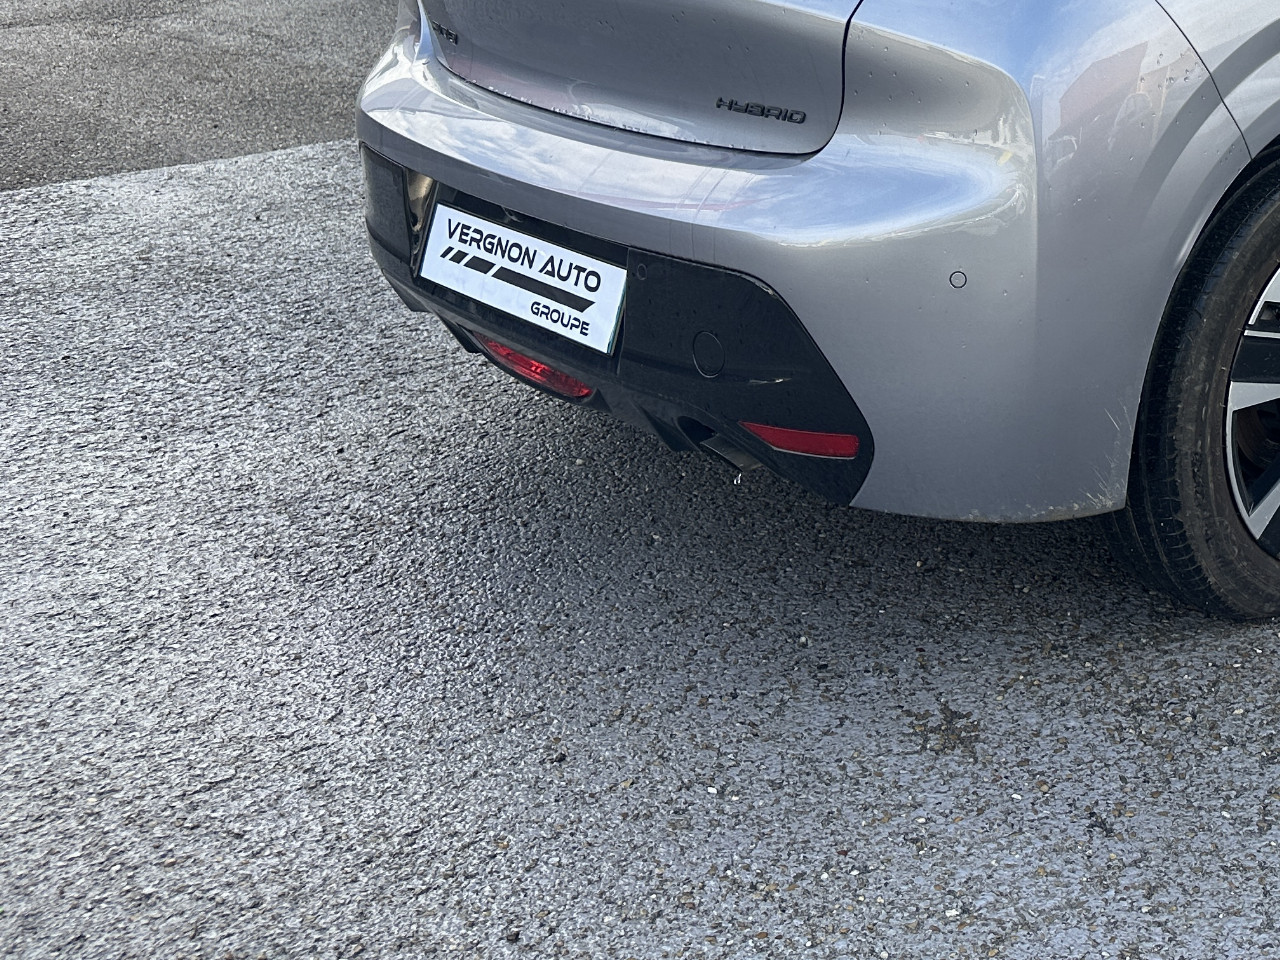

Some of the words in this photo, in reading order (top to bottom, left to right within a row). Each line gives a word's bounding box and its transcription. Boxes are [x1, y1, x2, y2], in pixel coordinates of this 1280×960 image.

[715, 96, 807, 125] HYBRID
[447, 218, 538, 270] VERGNON
[538, 254, 602, 293] AUTO
[530, 300, 591, 337] GROUPE
